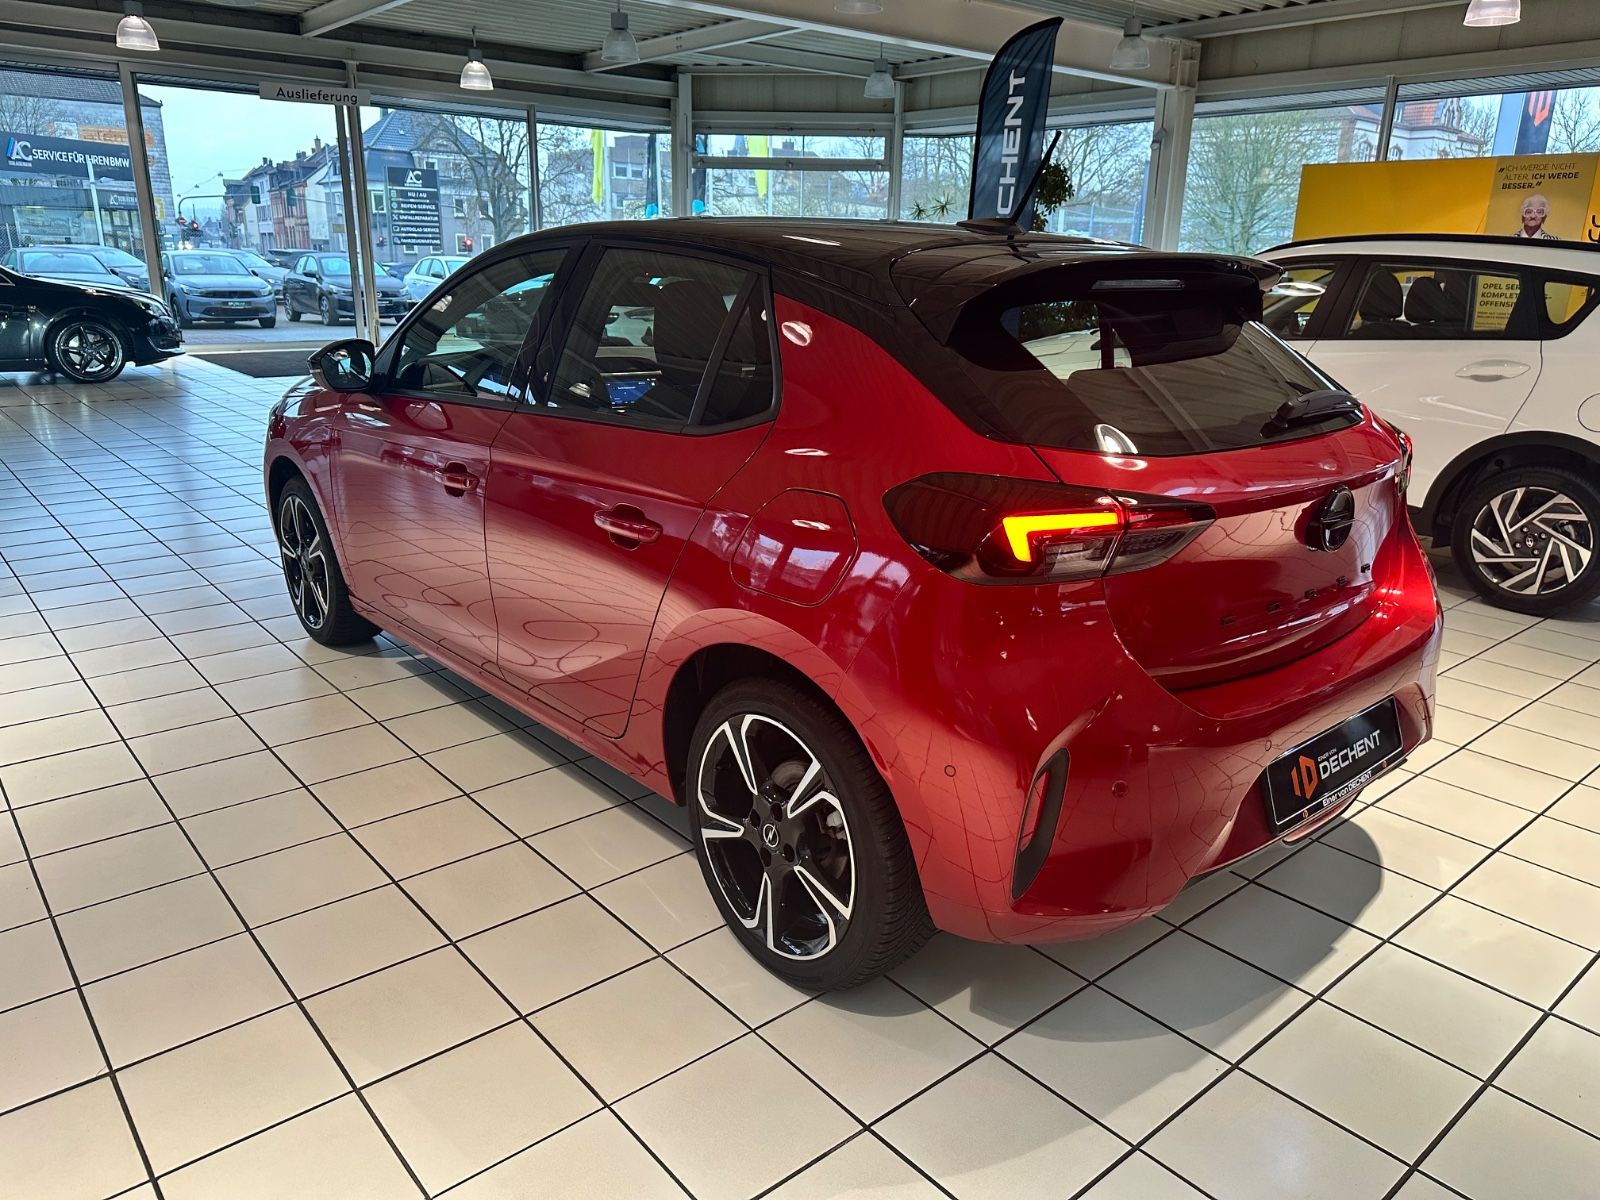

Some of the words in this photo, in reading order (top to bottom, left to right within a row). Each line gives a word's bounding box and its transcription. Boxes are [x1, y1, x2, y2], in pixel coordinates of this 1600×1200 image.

[276, 87, 358, 105] Auslieferung
[996, 69, 1026, 215] CHENT
[32, 149, 68, 162] SERVICE
[68, 151, 85, 164] FÜR
[110, 156, 130, 168] BMW
[1520, 163, 1550, 171] WERDE
[1551, 162, 1576, 171] NICHT
[1531, 172, 1546, 180] ICH
[1548, 171, 1580, 180] WERDE
[1482, 282, 1503, 290] OPEL
[1505, 283, 1520, 291] SER
[1481, 291, 1519, 299] KOMPLET
[1479, 300, 1514, 308] OFFENSI
[1319, 729, 1380, 780] DECHENT
[1347, 770, 1372, 792] DECHENT
